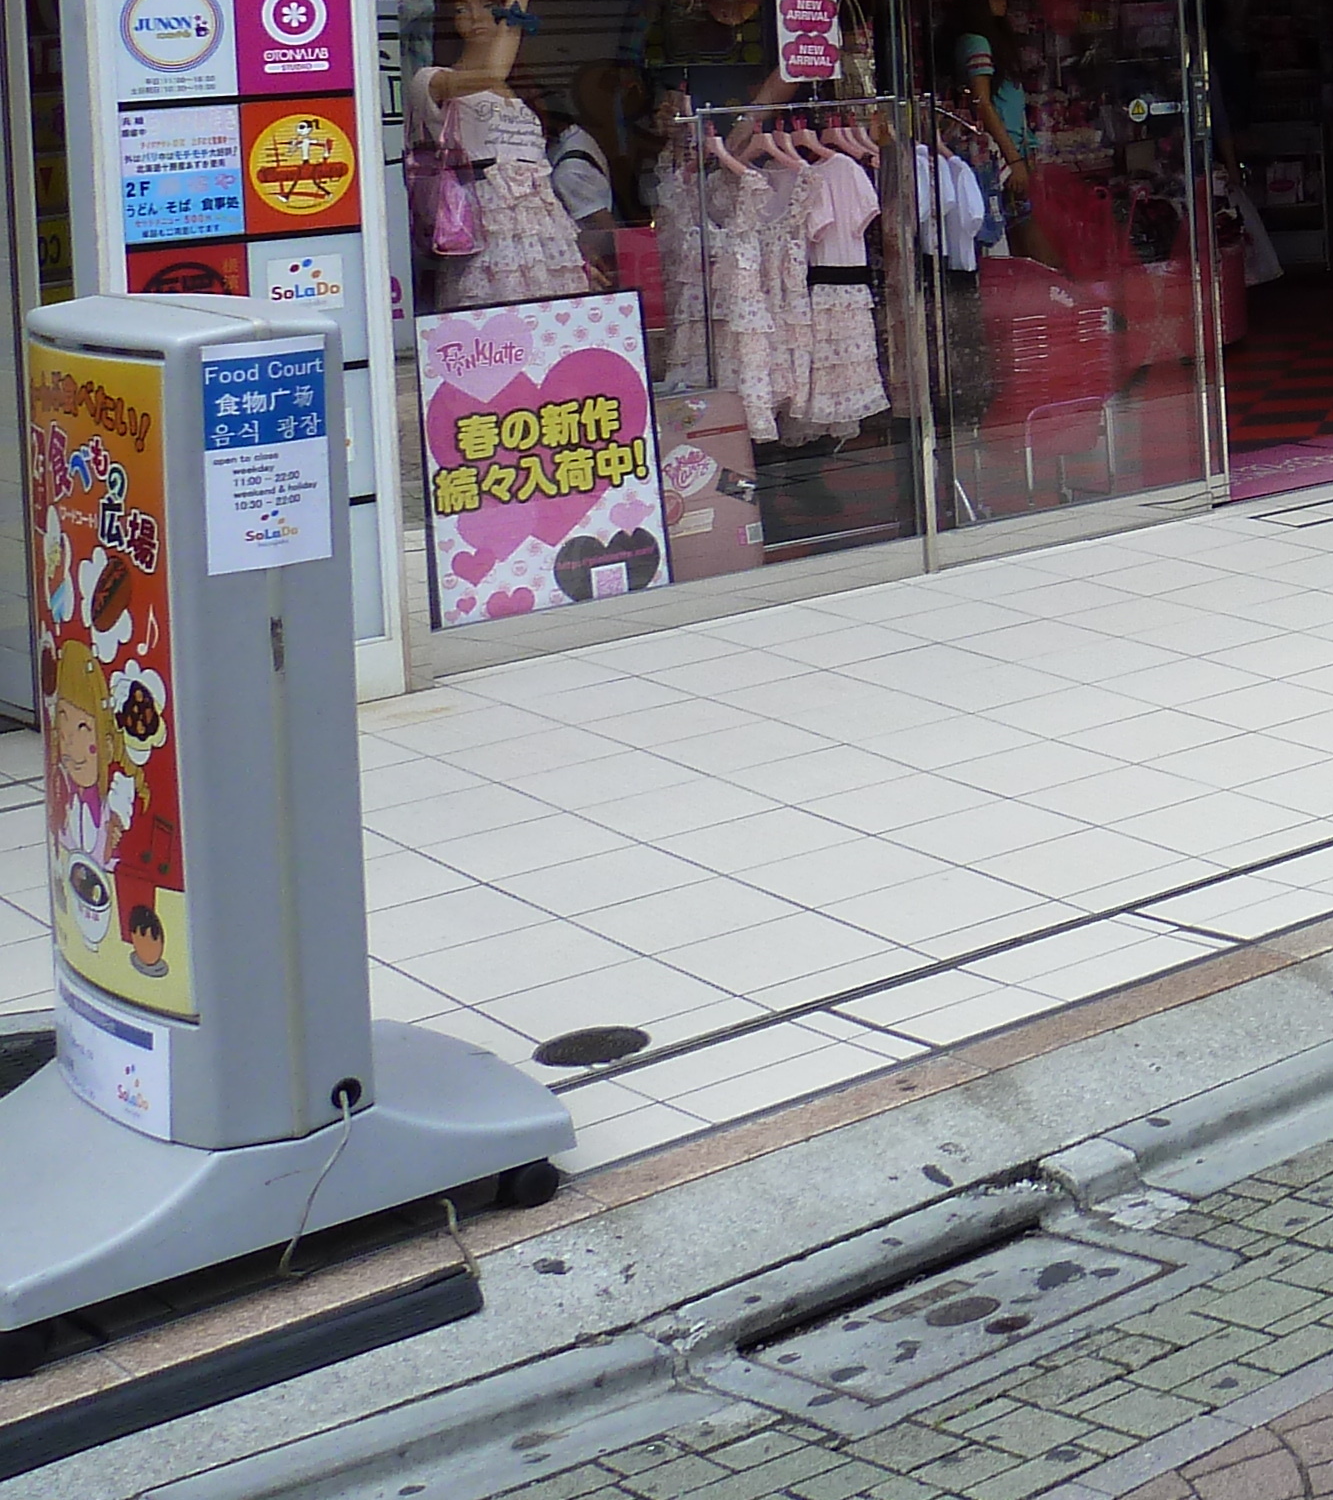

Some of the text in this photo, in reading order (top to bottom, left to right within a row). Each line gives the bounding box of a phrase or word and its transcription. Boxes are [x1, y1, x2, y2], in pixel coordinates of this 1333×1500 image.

[796, 0, 823, 10] NEW
[134, 15, 192, 32] JUNON
[786, 10, 831, 22] ARRIVAL
[799, 45, 825, 55] NEW
[789, 55, 833, 67] ARRIVAL
[126, 202, 158, 218] うどん
[166, 199, 192, 214] そば
[271, 281, 340, 301] SoLaDo
[204, 357, 324, 386] Food Court
[215, 385, 314, 418] 食物广场
[210, 412, 323, 447] 음식 광장
[456, 396, 621, 461] 春の新作
[213, 456, 237, 466] open
[253, 451, 279, 462] close
[232, 463, 275, 475] weekday
[434, 438, 650, 516] 続々入荷中!
[233, 470, 301, 488] 11:00 22:00
[233, 485, 277, 499] weekend
[287, 480, 318, 492] holiday
[234, 499, 263, 511] 10:30
[244, 526, 299, 542] SoLaDo
